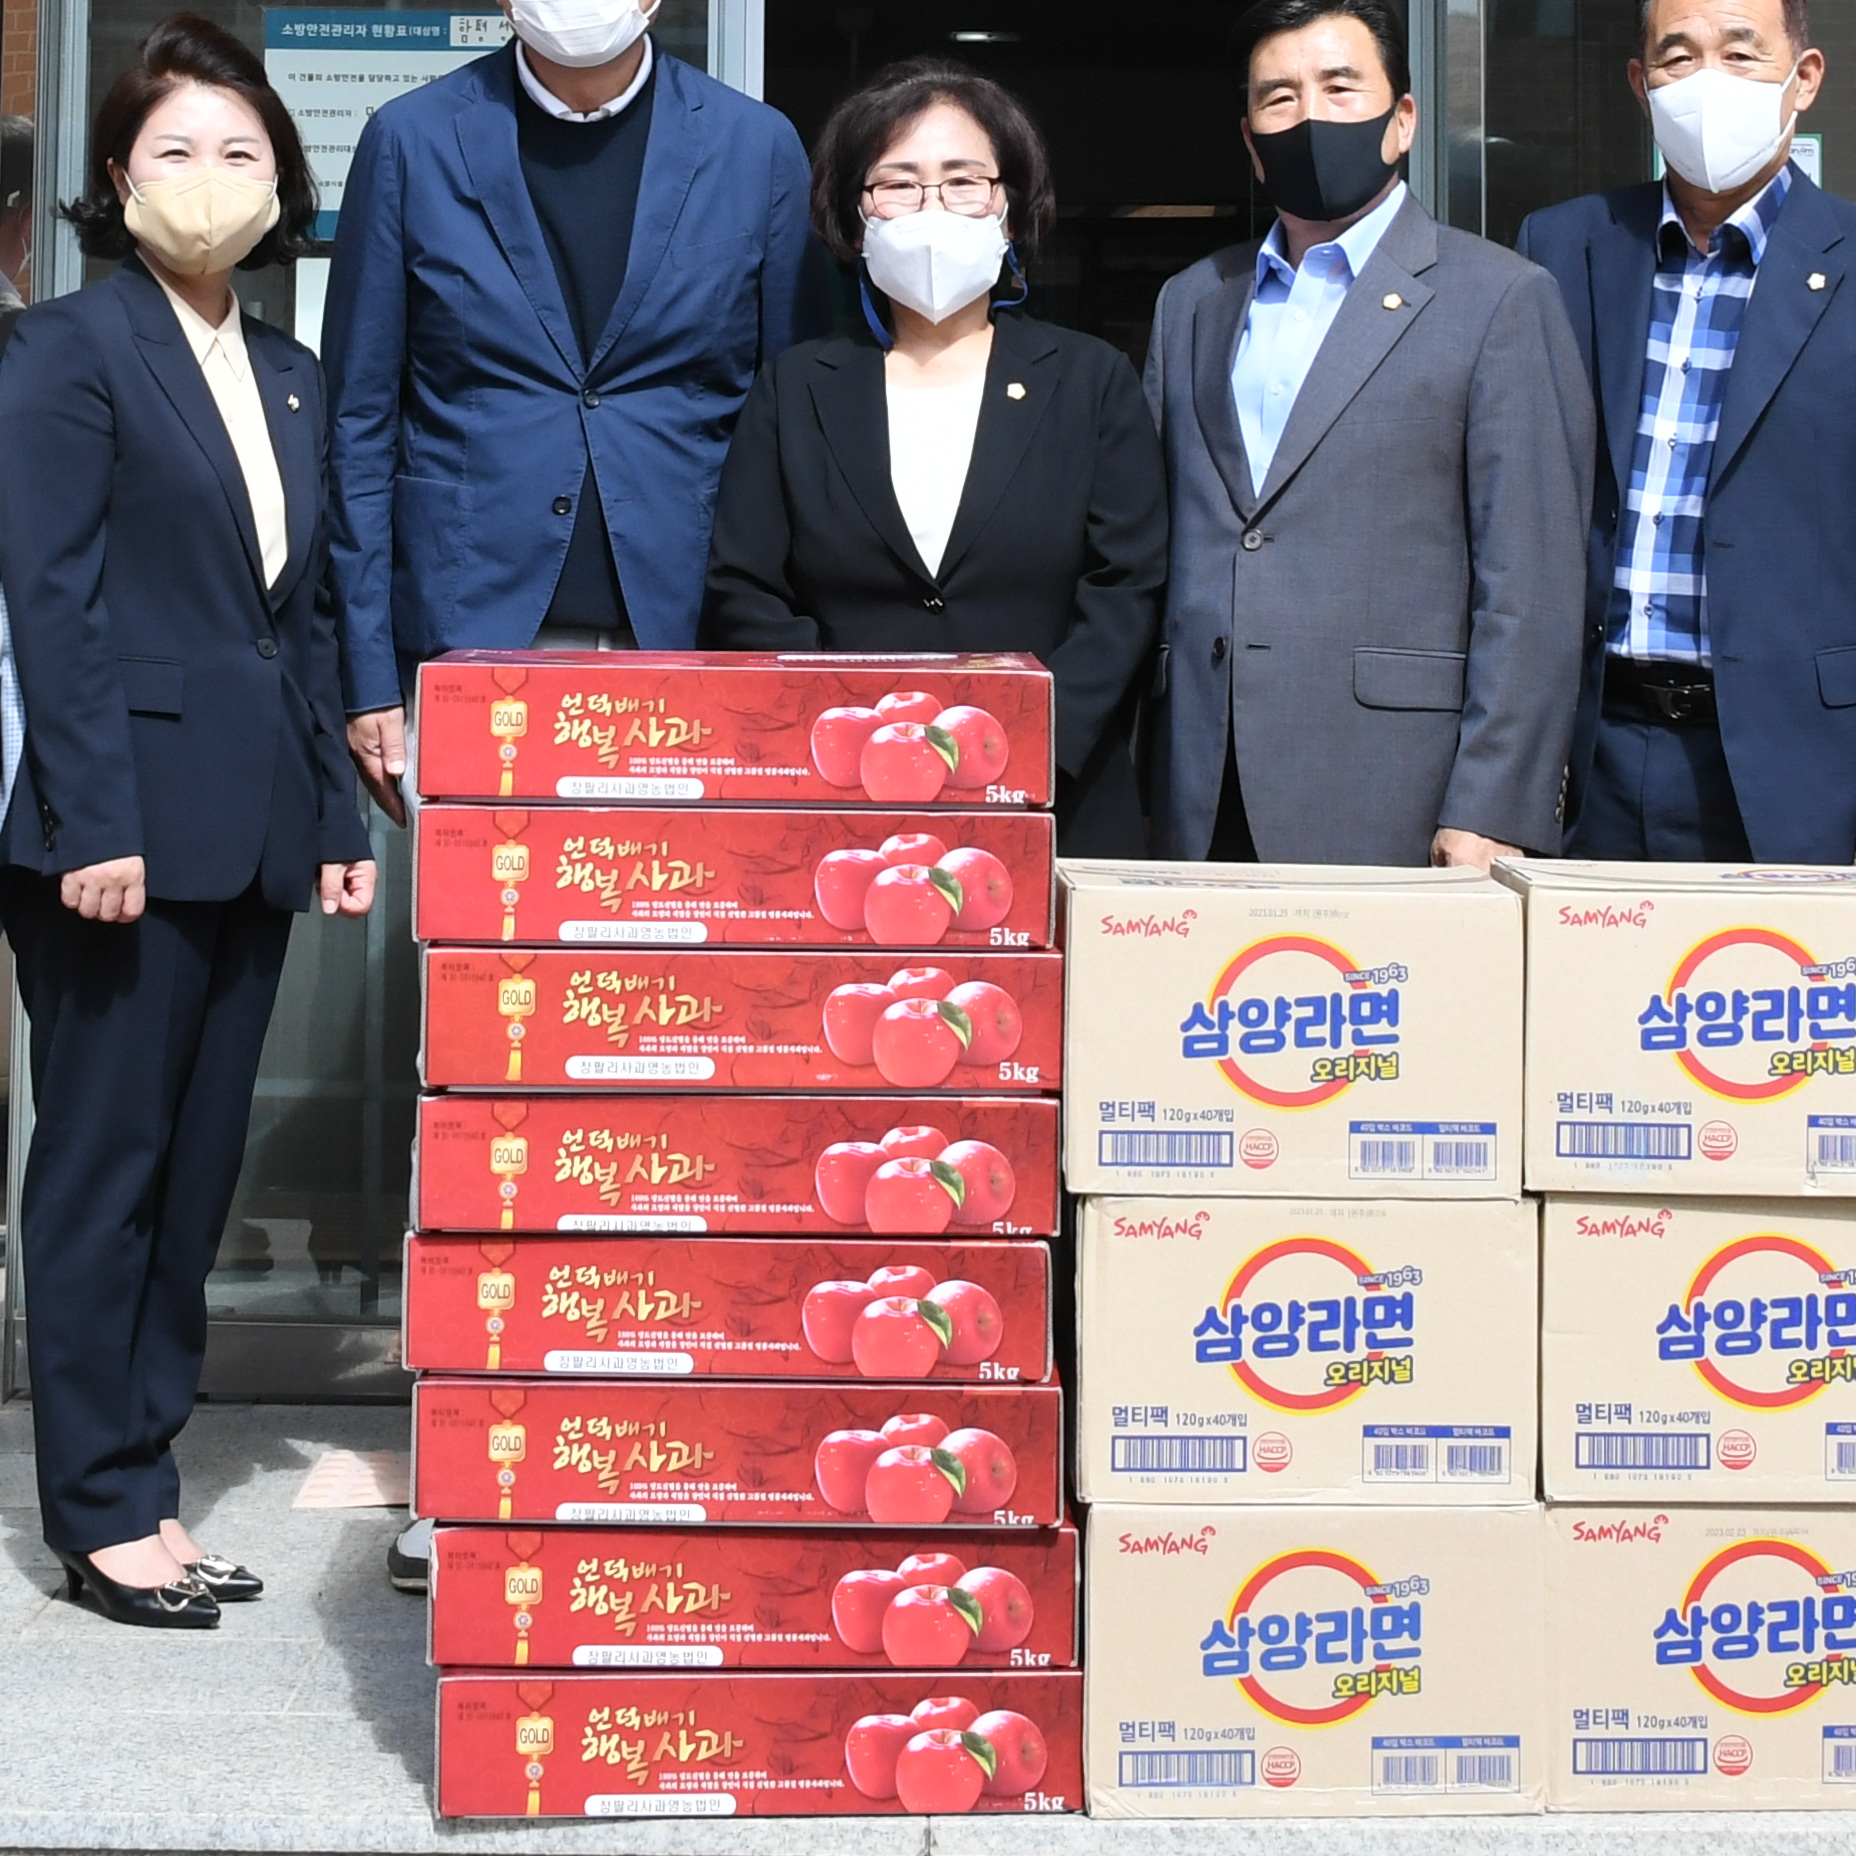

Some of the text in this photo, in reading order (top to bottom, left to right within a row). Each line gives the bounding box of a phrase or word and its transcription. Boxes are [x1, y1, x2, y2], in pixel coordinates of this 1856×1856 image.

[281, 23, 367, 38] 소방안전관리자
[299, 73, 323, 82] 건물의
[326, 73, 365, 83] 소방안전을
[368, 74, 400, 83] 담당하고
[403, 74, 418, 83] 있는
[298, 109, 352, 118] 소방안전관리자
[560, 692, 665, 716] 언덕배기
[494, 710, 523, 726] GOLD
[553, 710, 619, 768] 행복
[622, 716, 712, 747] 사과
[985, 785, 1026, 803] 5kg
[563, 836, 668, 860] 언덕배기
[496, 854, 525, 871] GOLD
[555, 854, 622, 913] 행복
[625, 859, 715, 891] 사과
[1100, 914, 1190, 938] SAMYANG
[1557, 905, 1647, 929] SAMYANG
[991, 927, 1031, 945] 5kg
[1344, 963, 1406, 982] SINCE 1963
[1802, 965, 1827, 975] SINCE
[569, 970, 675, 995] 언덕배기
[502, 989, 531, 1005] GOLD
[562, 988, 629, 1048] 행복
[632, 993, 722, 1025] 사과
[1180, 988, 1400, 1058] 삼양라면
[1638, 980, 1856, 1052] 삼양라면
[1000, 1062, 1040, 1082] 5kg
[1312, 1054, 1398, 1082] 오리지널
[1770, 1047, 1856, 1076] 오리지널
[1099, 1100, 1234, 1122] 멀티팩 120gx40개입
[1557, 1092, 1692, 1115] 멀티팩 120gx40개입
[561, 1128, 667, 1153] 언덕배기
[494, 1147, 523, 1164] GOLD
[554, 1146, 621, 1206] 행복
[624, 1151, 714, 1184] 사과
[1112, 1216, 1203, 1240] SAMYANG
[1575, 1215, 1665, 1238] SAMYANG
[549, 1265, 654, 1289] 언덕배기
[1358, 1266, 1420, 1286] SINCE 1963
[1820, 1272, 1845, 1282] SINCE
[481, 1283, 511, 1299] GOLD
[540, 1282, 608, 1342] 행복
[611, 1288, 701, 1321] 사과
[1194, 1291, 1414, 1362] 삼양라면
[979, 1362, 1020, 1380] 5kg
[1326, 1357, 1412, 1386] 오리지널
[1112, 1405, 1247, 1427] 멀티팩 120gx40개입
[1576, 1403, 1710, 1425] 멀티팩 120gx40개입
[560, 1416, 666, 1441] 언덕배기
[492, 1435, 521, 1451] GOLD
[1259, 1447, 1286, 1455] HACCP
[552, 1434, 619, 1494] 행복
[622, 1439, 714, 1472] 사과
[1572, 1519, 1662, 1544] SAMYANG
[1118, 1531, 1209, 1556] SAMYANG
[576, 1557, 683, 1583] 언덕배기
[1816, 1575, 1842, 1585] SINCE
[509, 1577, 538, 1594] GOLD
[1365, 1576, 1427, 1596] SINCE 1963
[569, 1576, 636, 1637] 행복
[639, 1580, 731, 1614] 사과
[1200, 1602, 1421, 1675] 삼양라면
[1011, 1649, 1051, 1666] 5kg
[1333, 1668, 1420, 1698] 오리지널
[588, 1705, 695, 1731] 언덕배기
[1573, 1708, 1707, 1730] 멀티팩 120gx40개입
[519, 1727, 549, 1744] GOLD
[1119, 1720, 1255, 1743] 멀티팩 120gx40개입
[580, 1724, 649, 1786] 행복
[651, 1728, 743, 1762] 사과
[1720, 1749, 1746, 1757] HACCP
[1025, 1792, 1064, 1811] 5kg
